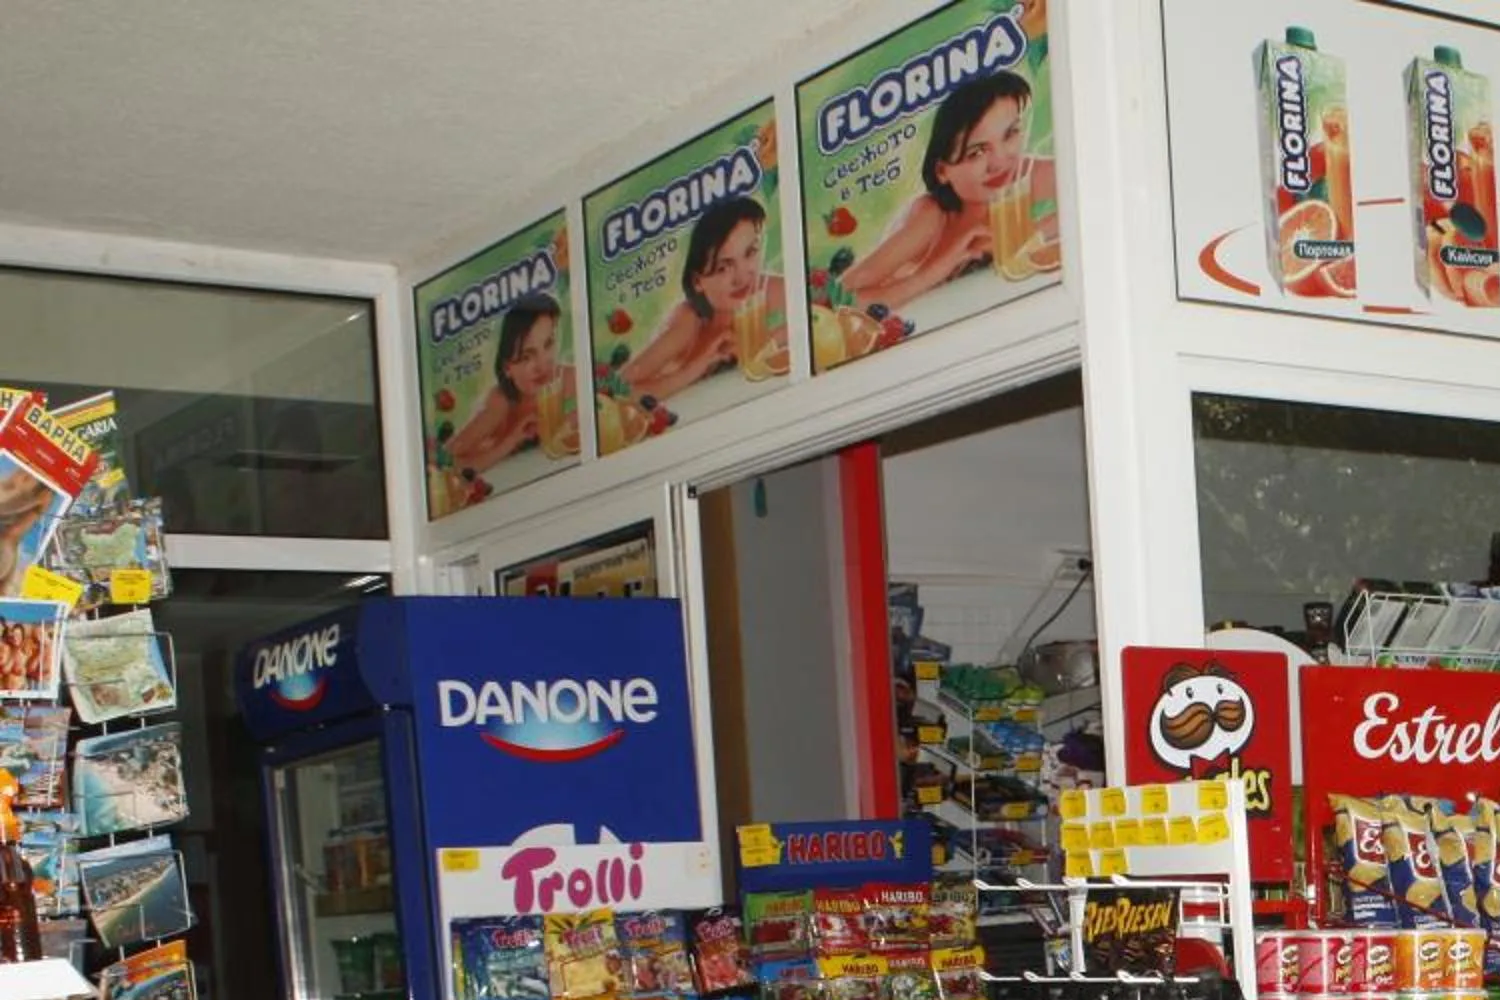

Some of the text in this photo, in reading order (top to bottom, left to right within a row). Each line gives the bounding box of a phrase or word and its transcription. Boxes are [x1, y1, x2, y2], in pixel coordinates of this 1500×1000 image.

[821, 20, 1021, 150] FLORINA
[1279, 56, 1309, 192] FLORINA
[1428, 71, 1456, 198] FLORINA
[604, 149, 759, 257] FLORINA
[432, 254, 555, 340] FLORINA
[27, 406, 86, 462] ВАРНА
[253, 623, 340, 690] DANONE
[438, 677, 659, 728] DANONE
[502, 843, 645, 914] Trolli
[787, 830, 884, 865] HARIBO
[881, 891, 924, 904] HARIBO
